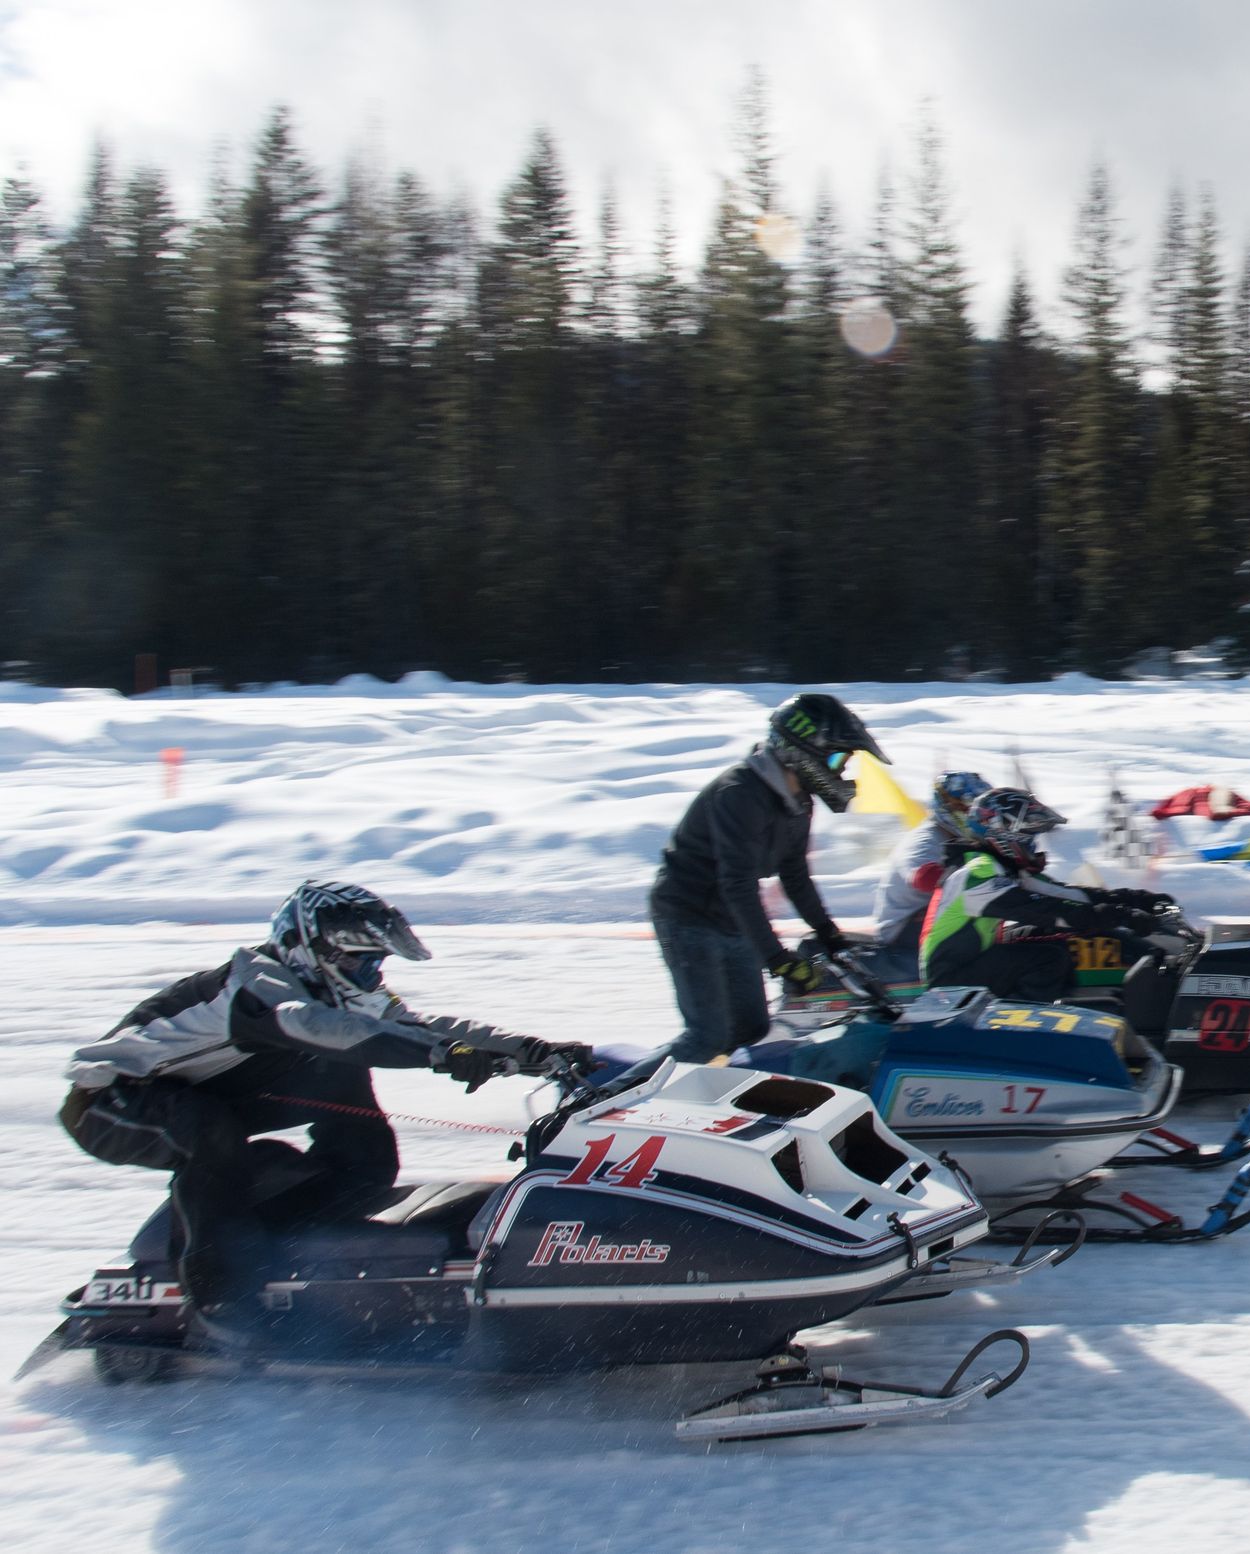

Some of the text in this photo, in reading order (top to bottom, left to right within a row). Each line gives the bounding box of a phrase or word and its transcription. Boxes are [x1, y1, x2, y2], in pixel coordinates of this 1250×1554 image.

[1001, 1084, 1047, 1114] 17
[552, 1132, 668, 1190] 14
[526, 1221, 671, 1267] Polaris
